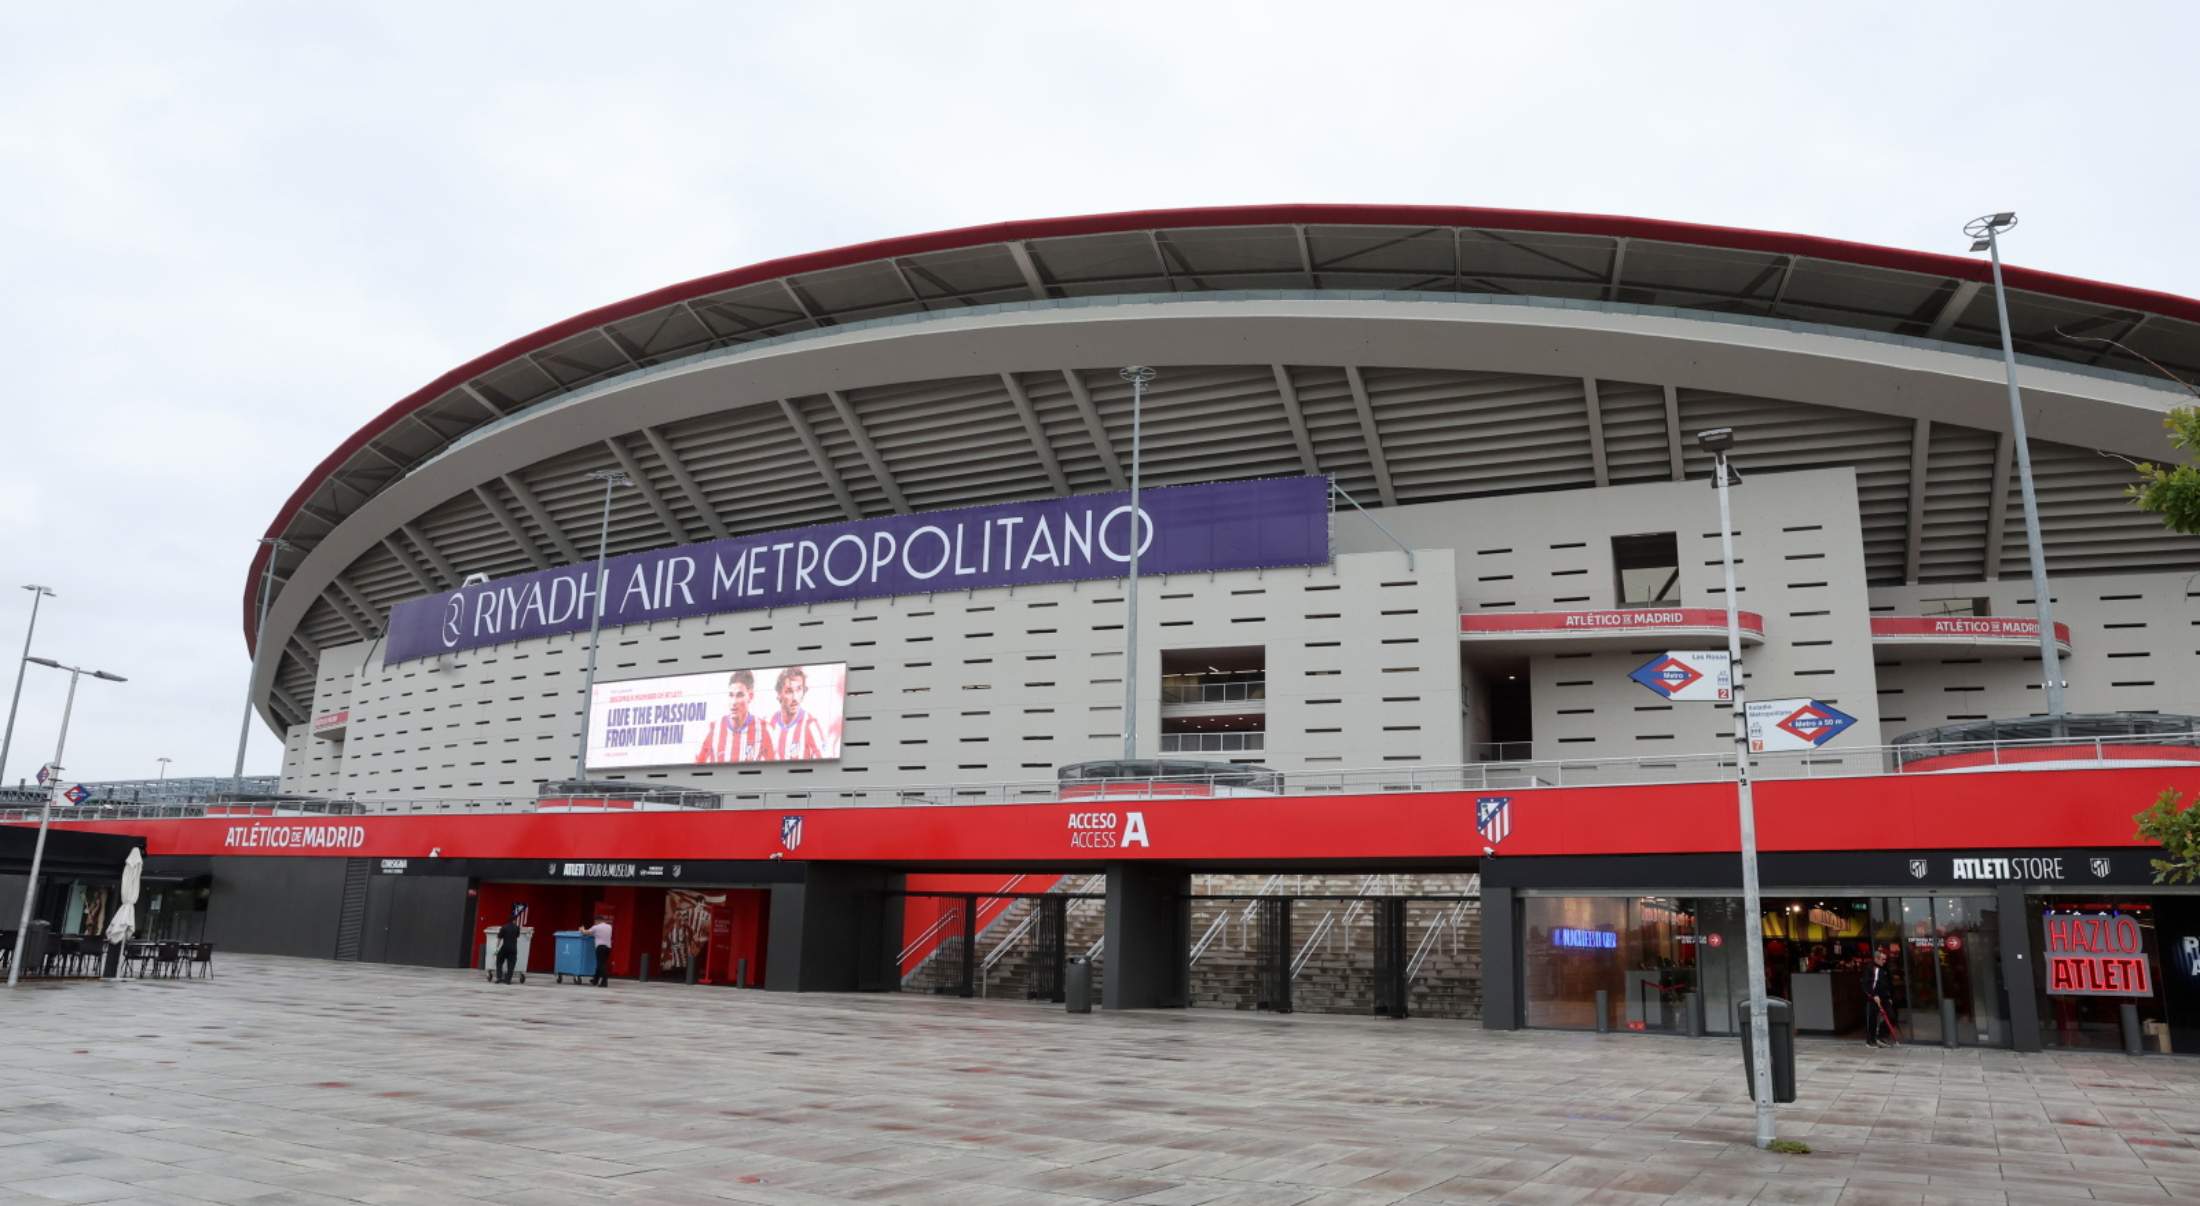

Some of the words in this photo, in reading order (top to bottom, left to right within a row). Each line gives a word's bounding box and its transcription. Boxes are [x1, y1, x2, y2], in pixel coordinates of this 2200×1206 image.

[473, 569, 609, 637] RIYADH
[619, 556, 696, 615] AIR
[711, 505, 1154, 600] METROPOLITANO
[1566, 613, 1621, 626] ATLÉTICO
[1634, 613, 1683, 624] MADRID
[1935, 619, 1989, 632] ATLÉTICO
[608, 708, 631, 727] LIVE
[633, 705, 652, 725] THE
[655, 702, 707, 723] PASSION
[605, 728, 636, 748] FROM
[638, 724, 684, 746] WITHIN
[225, 822, 290, 848] ATLÉTICO
[303, 827, 364, 848] MADRID
[1068, 813, 1116, 828] ACCESO
[1120, 812, 1150, 847] A
[1071, 832, 1116, 848] ACCESS
[1953, 858, 2010, 879] ATLETI
[2012, 858, 2064, 879] STORE
[2049, 920, 2138, 953] HAZLO
[2053, 958, 2148, 992] ATLETI
